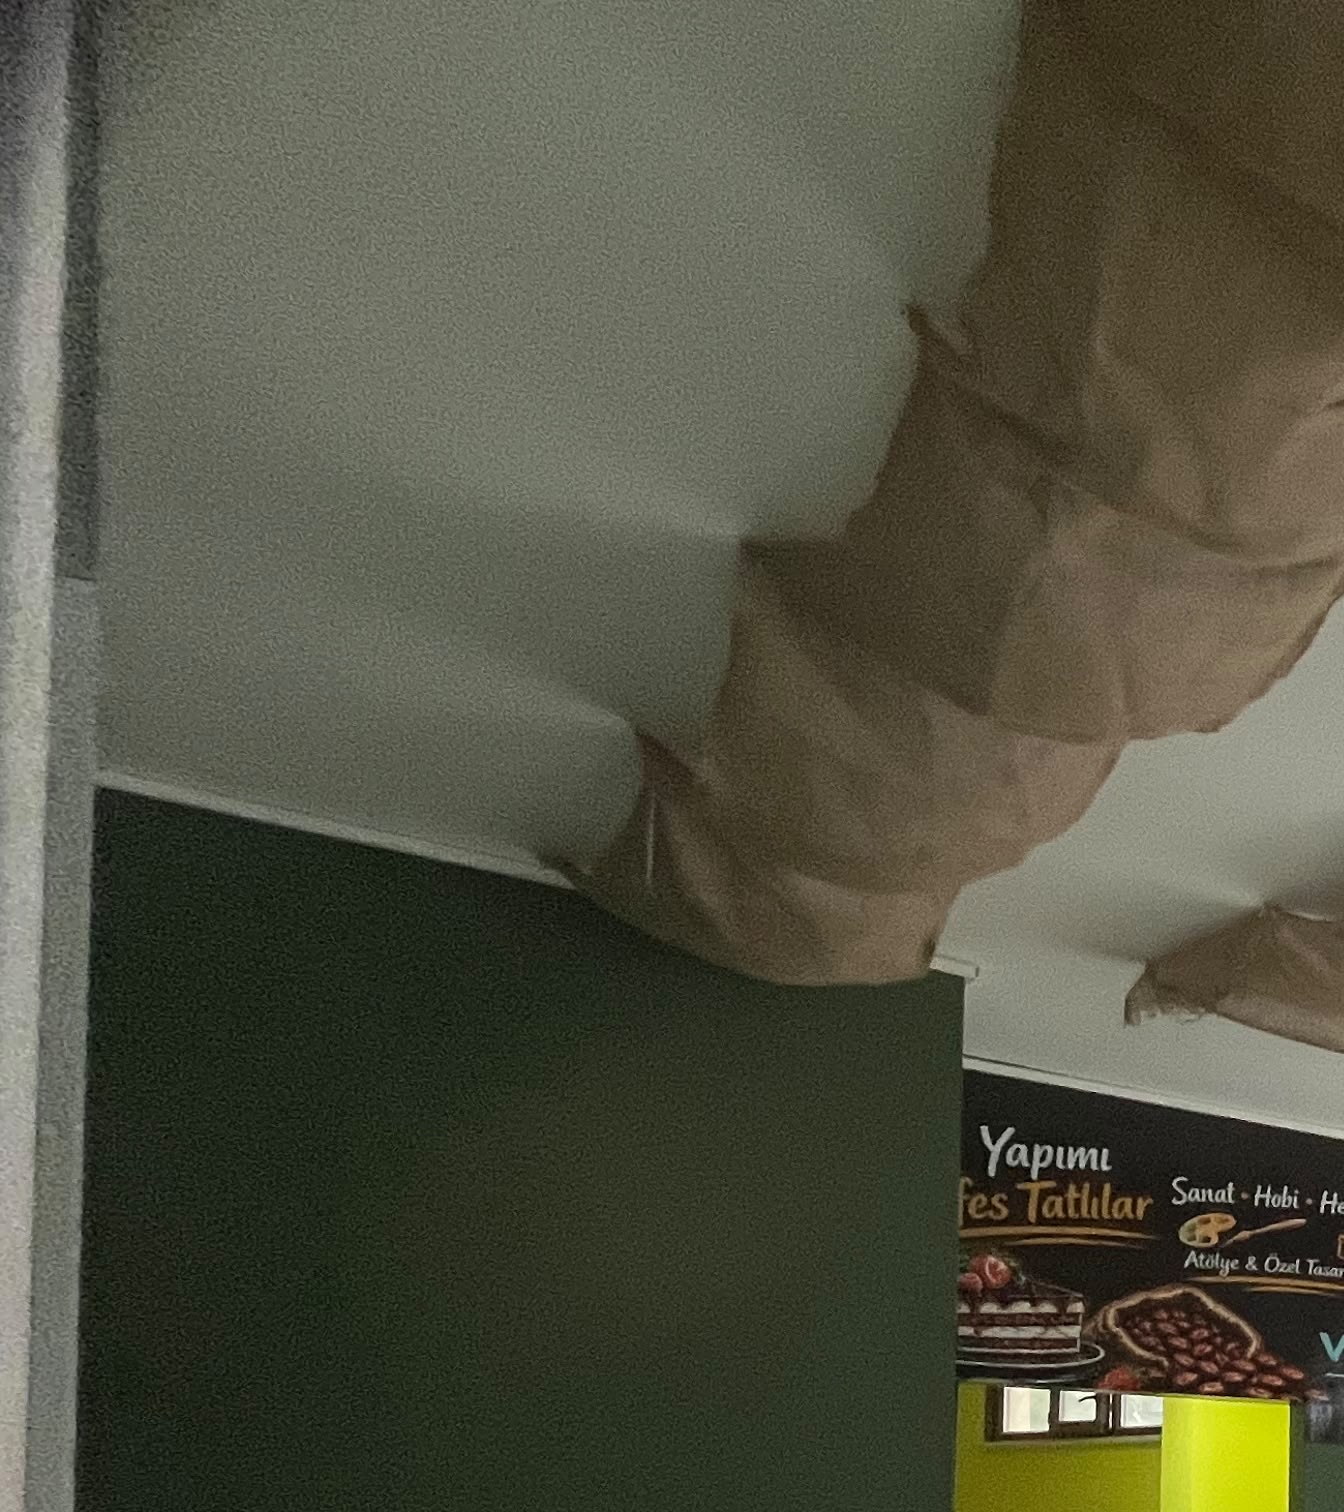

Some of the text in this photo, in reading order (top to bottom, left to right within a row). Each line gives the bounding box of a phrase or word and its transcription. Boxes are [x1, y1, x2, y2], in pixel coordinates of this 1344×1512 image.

[979, 1125, 1112, 1180] Yapımı
[1016, 1180, 1153, 1223] Tatlılar
[1171, 1176, 1235, 1206] Sanat
[1254, 1184, 1300, 1209] Hobi
[1183, 1250, 1240, 1277] Atölye
[1245, 1255, 1259, 1271] &
[1264, 1253, 1301, 1273] Özel
